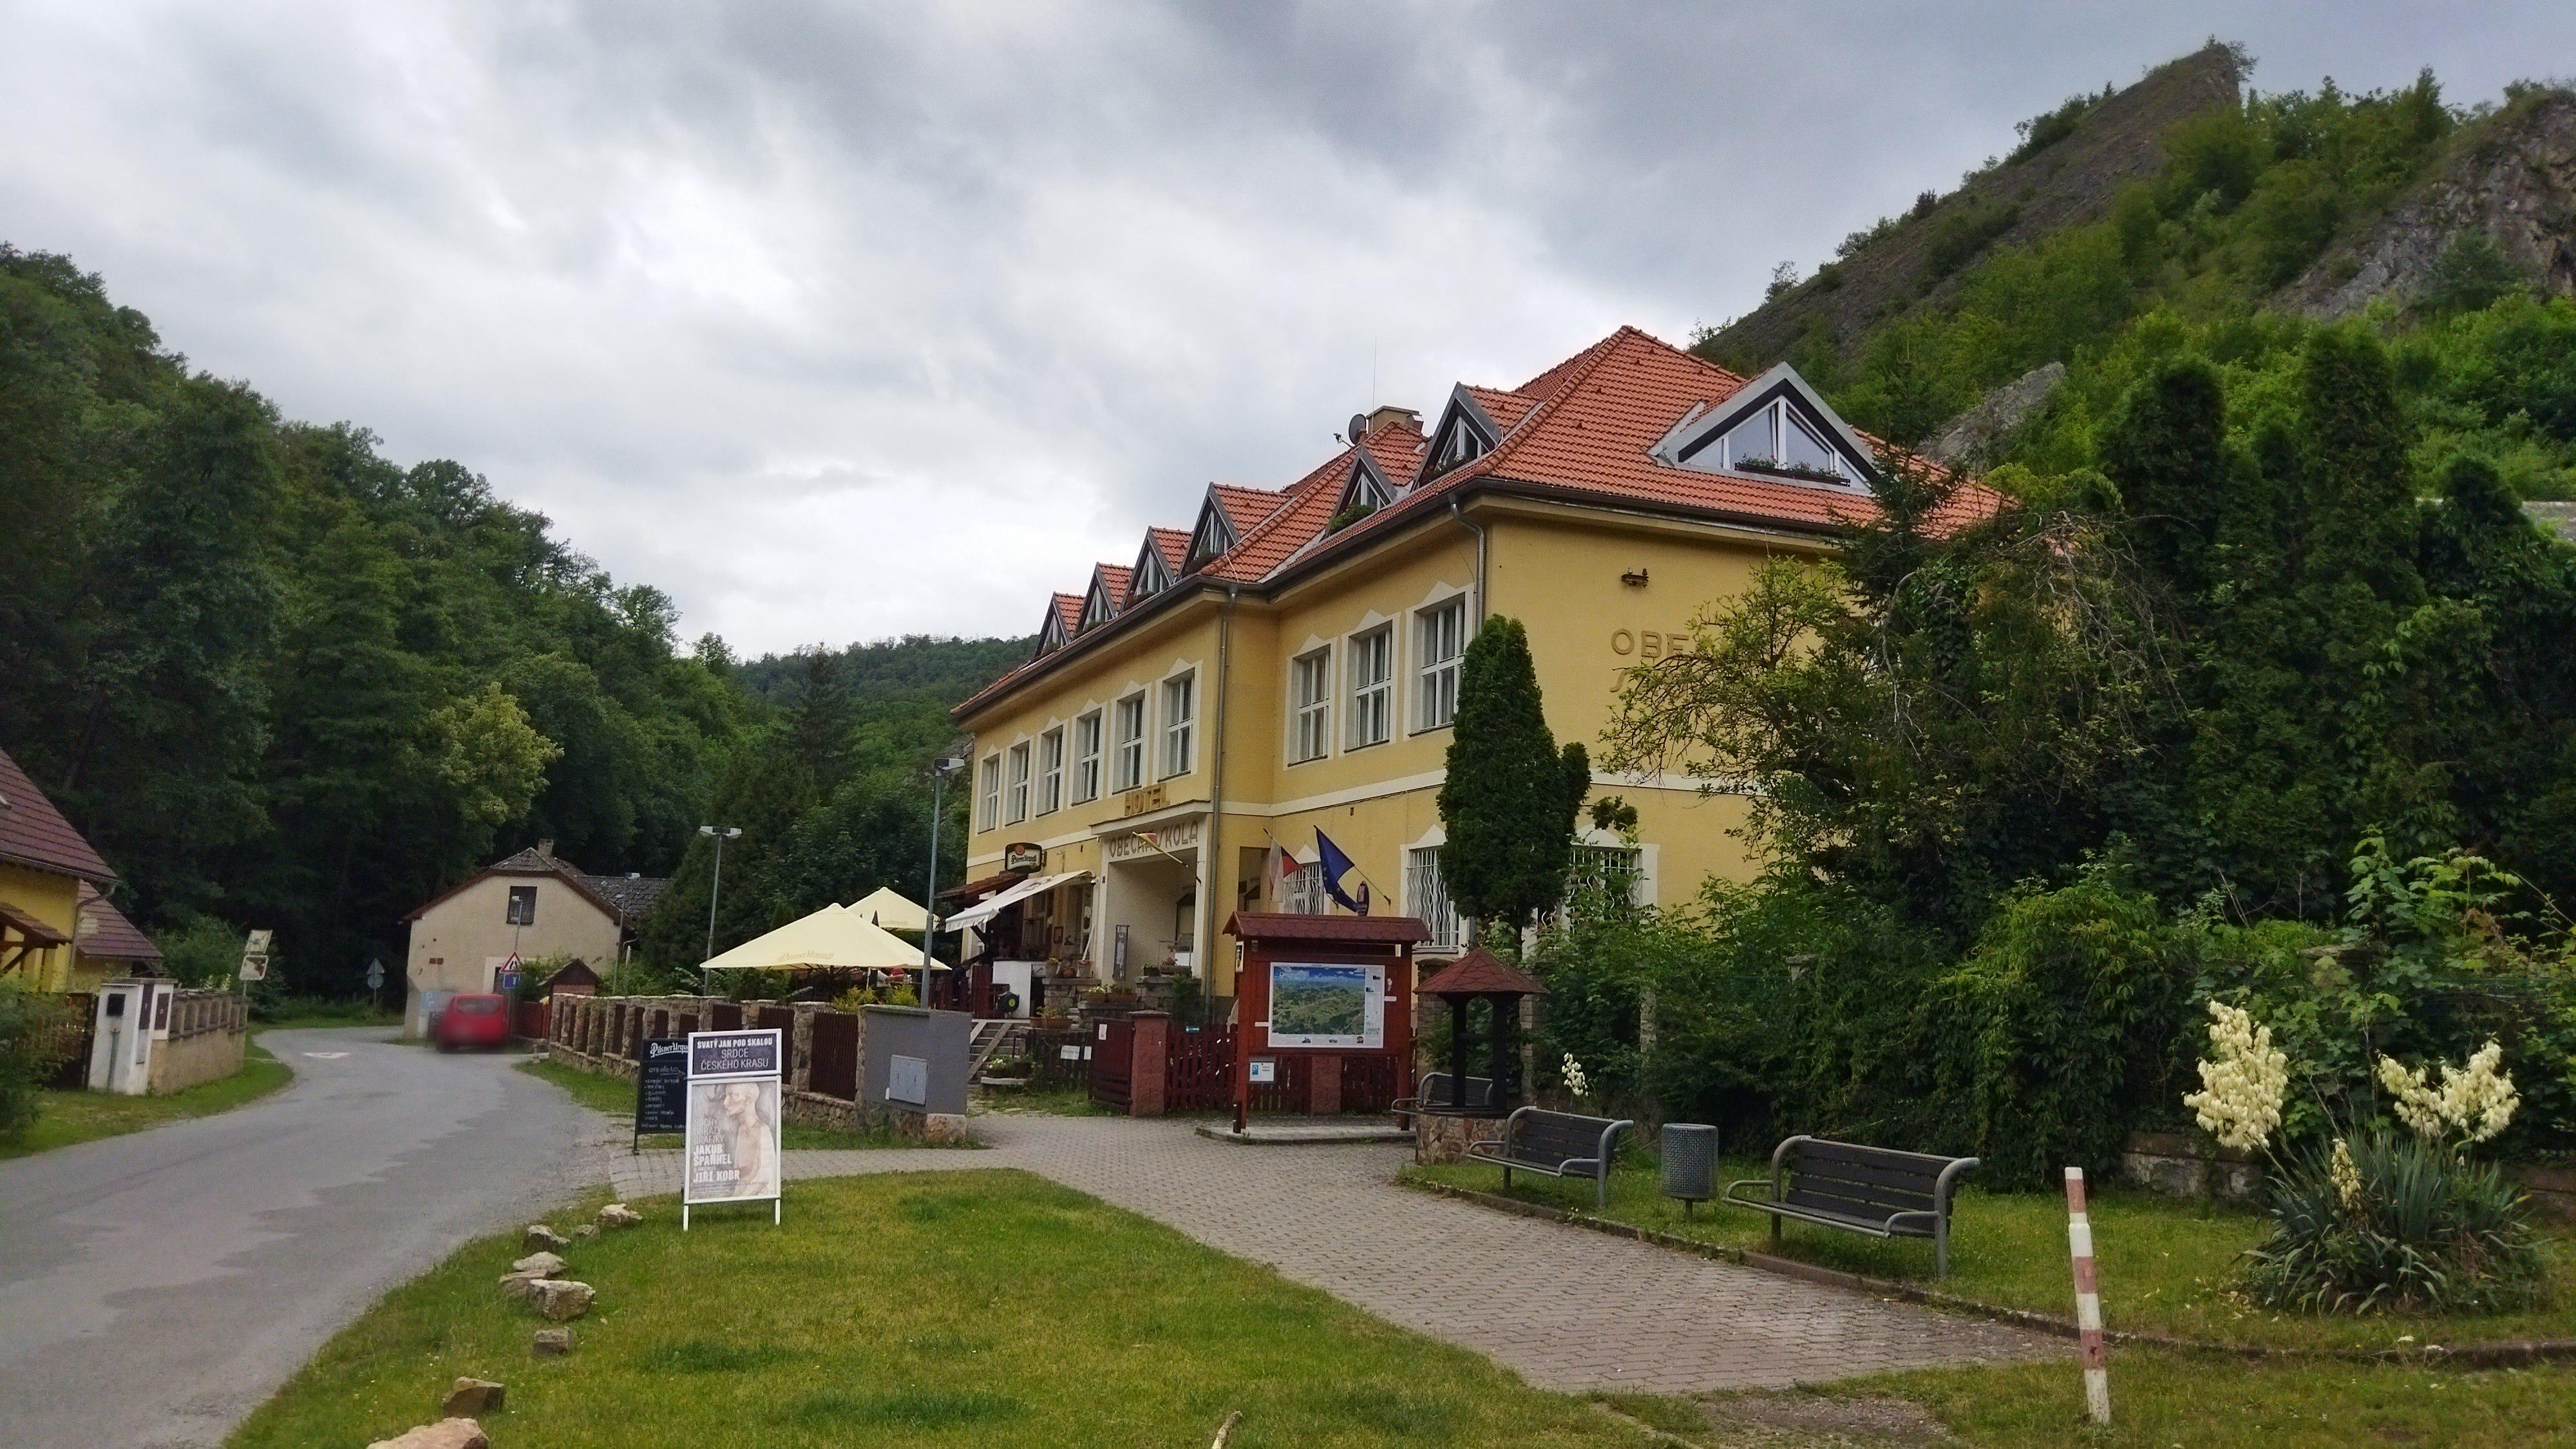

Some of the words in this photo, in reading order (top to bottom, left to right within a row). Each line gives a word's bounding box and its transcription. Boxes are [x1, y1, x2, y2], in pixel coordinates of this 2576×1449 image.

[1611, 628, 1690, 658] OBE
[1124, 783, 1170, 816] HOTEL
[697, 1038, 718, 1049] SVATÝ
[718, 1039, 732, 1048] JAN
[733, 1039, 746, 1047] POD
[747, 1037, 773, 1046] SKALOU
[650, 1043, 673, 1058] Pilsner
[721, 1048, 748, 1059] SRDCE
[701, 1057, 739, 1070] ČESKÉHO
[741, 1058, 768, 1068] KRASU
[694, 1144, 723, 1155] JAKUB
[717, 1170, 740, 1181] KOBR
